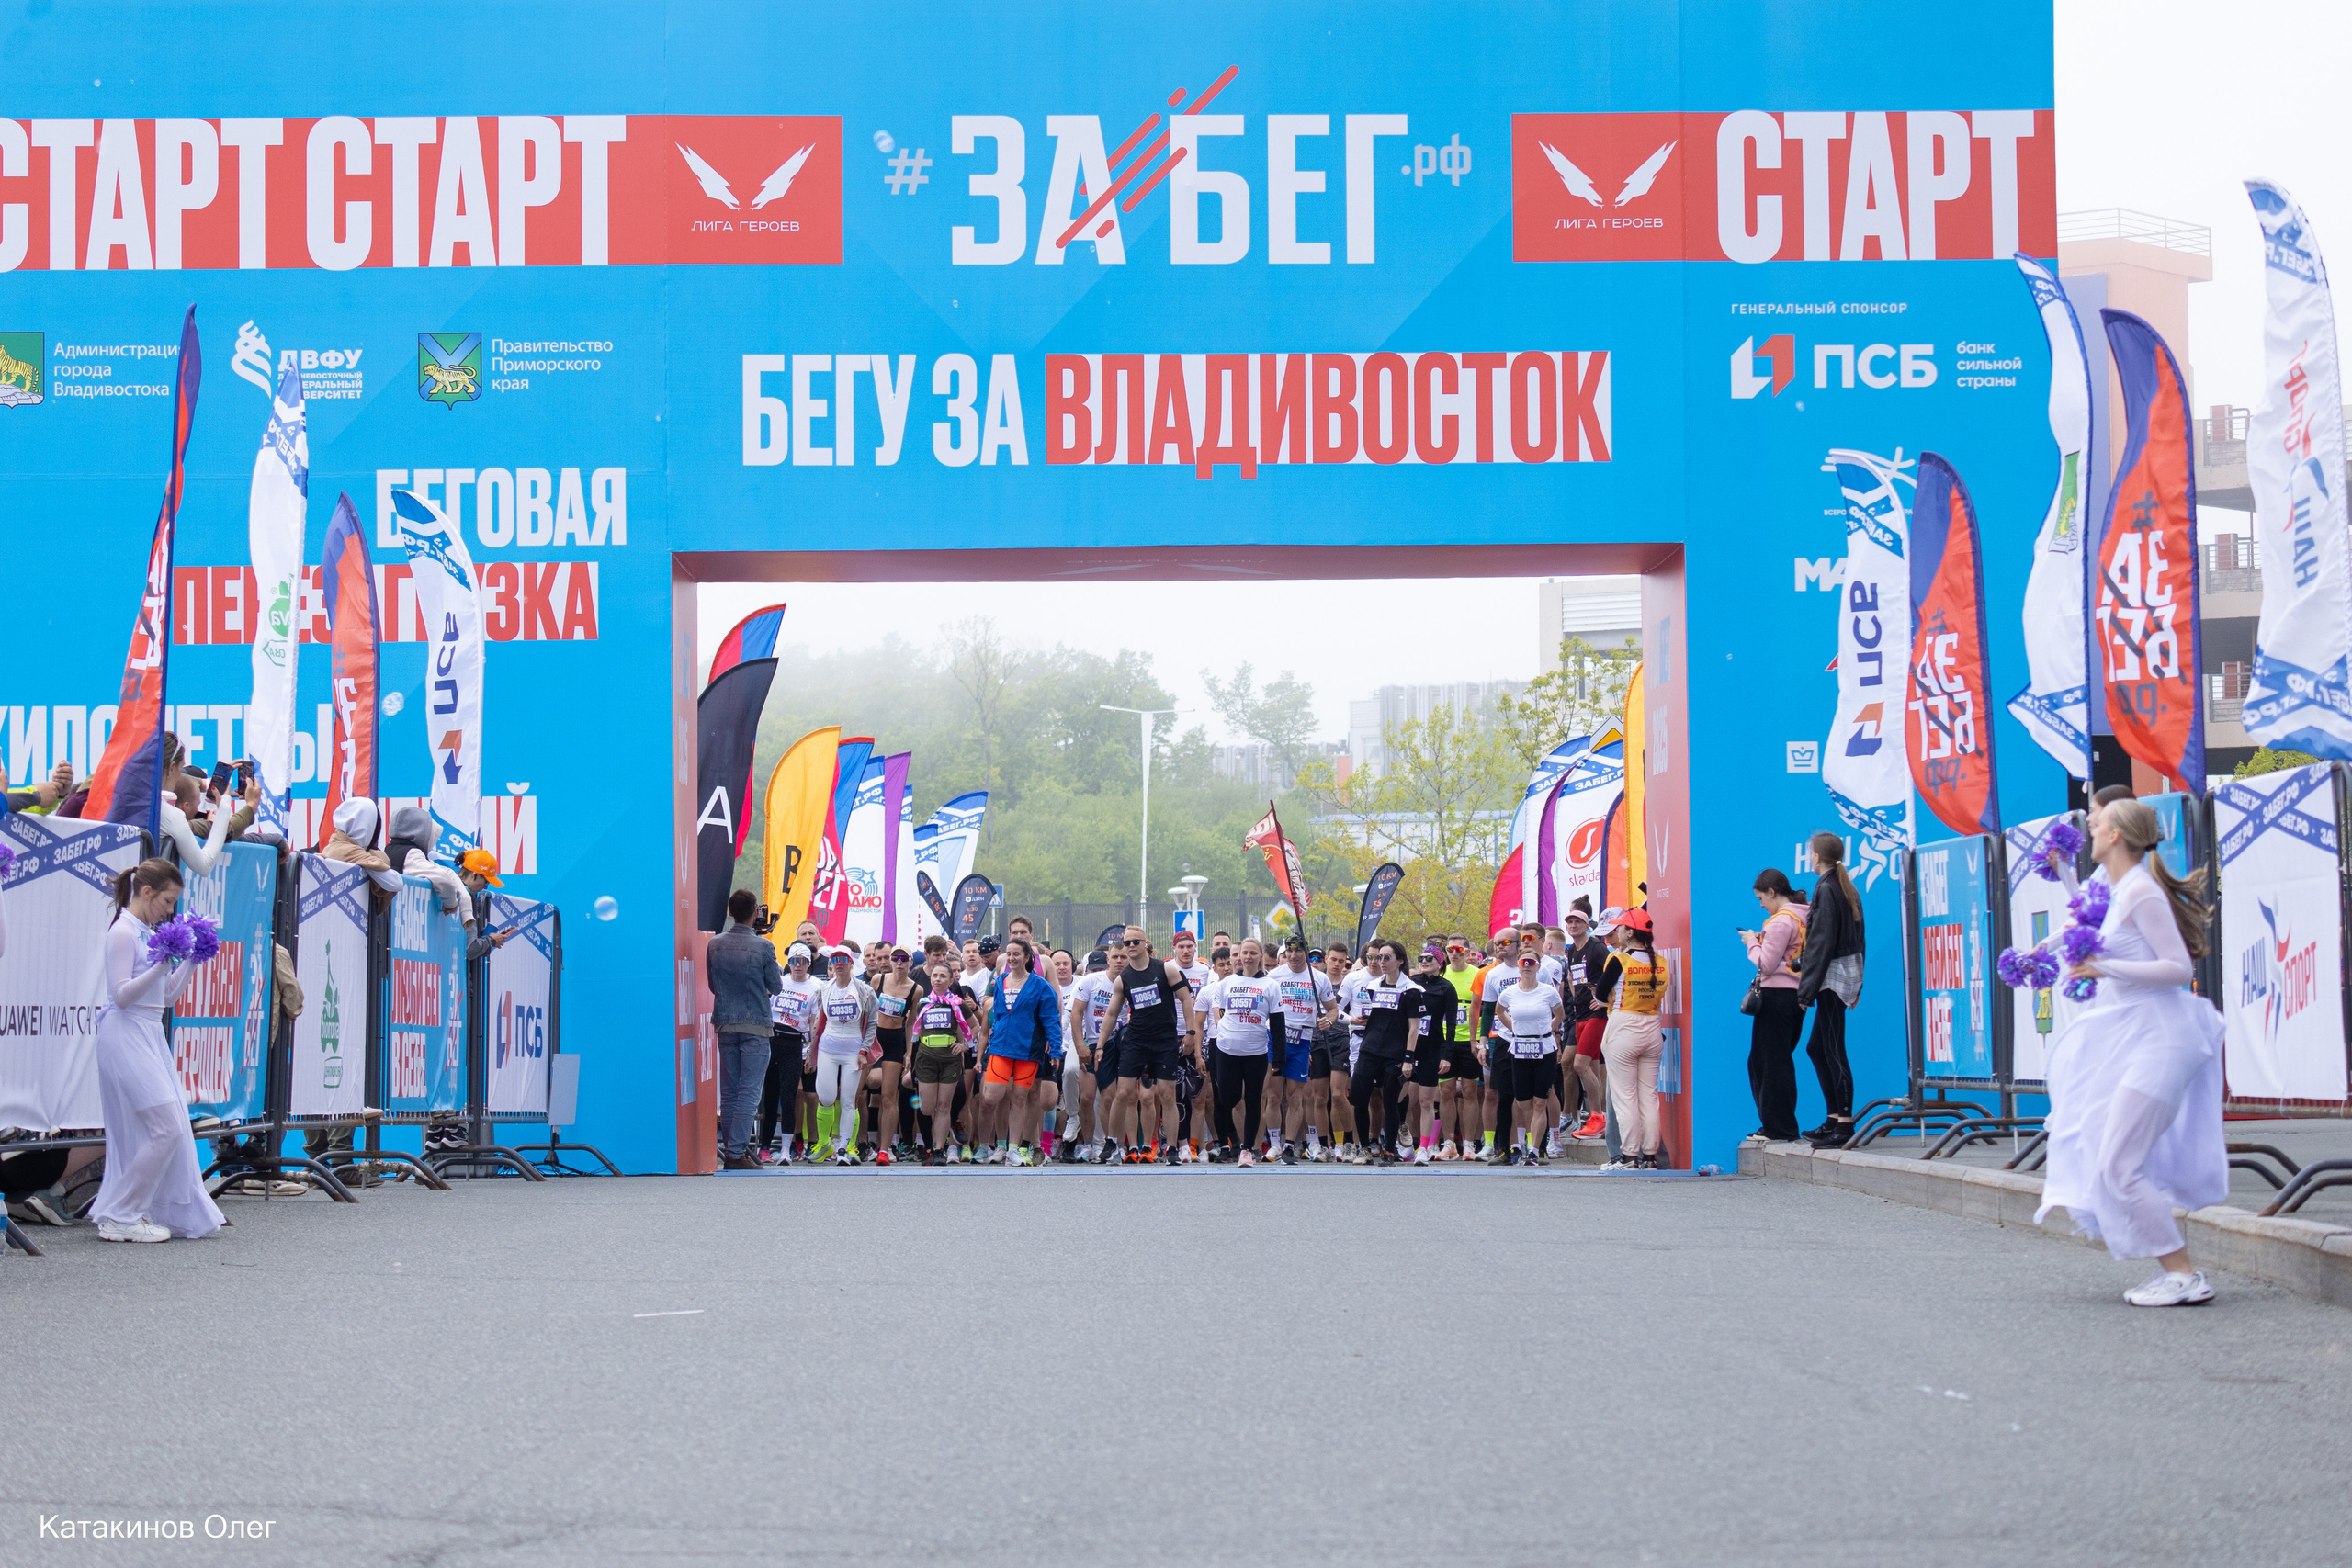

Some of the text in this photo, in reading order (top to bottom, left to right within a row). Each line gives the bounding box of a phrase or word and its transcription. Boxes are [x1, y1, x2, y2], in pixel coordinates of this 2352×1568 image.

[305, 115, 627, 271] СТАРТ
[1715, 108, 2036, 265] СТАРТ
[691, 220, 800, 231] ЛИГА ГЕРОЕВ
[1554, 218, 1664, 229] ЛИГА ГЕРОЕВ
[1731, 300, 1908, 315] ГЕНЕРАЛЬНЫЙ СПОНСОР
[53, 342, 180, 360] Администраци
[491, 339, 613, 354] Правительство
[1956, 341, 1996, 354] банк
[277, 349, 363, 371] ДВФУ
[491, 357, 602, 374] Приморского
[1813, 344, 1939, 389] ПСБ
[1956, 355, 2022, 371] сильной
[53, 365, 112, 380] города
[277, 371, 363, 380] ДНЕВОСТОЧНЫЙ
[278, 378, 363, 389] ЕРАЛЬНЫЙ
[491, 378, 530, 392] края
[1956, 373, 2017, 390] страны
[53, 381, 170, 399] Владивостока
[303, 389, 363, 400] ВЕРСИТЕТ
[741, 350, 1611, 481] БЕГУ ЗА ВЛАДИВОСТОК
[1574, 768, 1624, 791] ЗАБЕГ.Р
[2262, 781, 2300, 825] ЗАБЕГ.РФ
[2221, 819, 2255, 862] ЗАБЕГ.РФ
[53, 833, 103, 865] ЗАБЕГ.РФ
[964, 886, 974, 895] 10
[848, 895, 882, 908] ДИО
[393, 883, 432, 953] #ЗАБЕГ
[962, 913, 974, 922] 45
[1627, 966, 1666, 975] ВОЛОНЕР
[2240, 935, 2317, 1021] НАШ СПОРТ
[209, 941, 244, 1019] ВСЕМ
[424, 962, 443, 1027] БЕГ
[1134, 991, 1157, 1003] 30954
[831, 1005, 854, 1015] 30335
[1230, 998, 1253, 1008] 30557
[926, 1013, 948, 1023] 30534
[514, 1004, 543, 1059] ПСБ
[1286, 1028, 1299, 1039] 341
[1517, 1043, 1540, 1054] 30092
[391, 1032, 401, 1098] В
